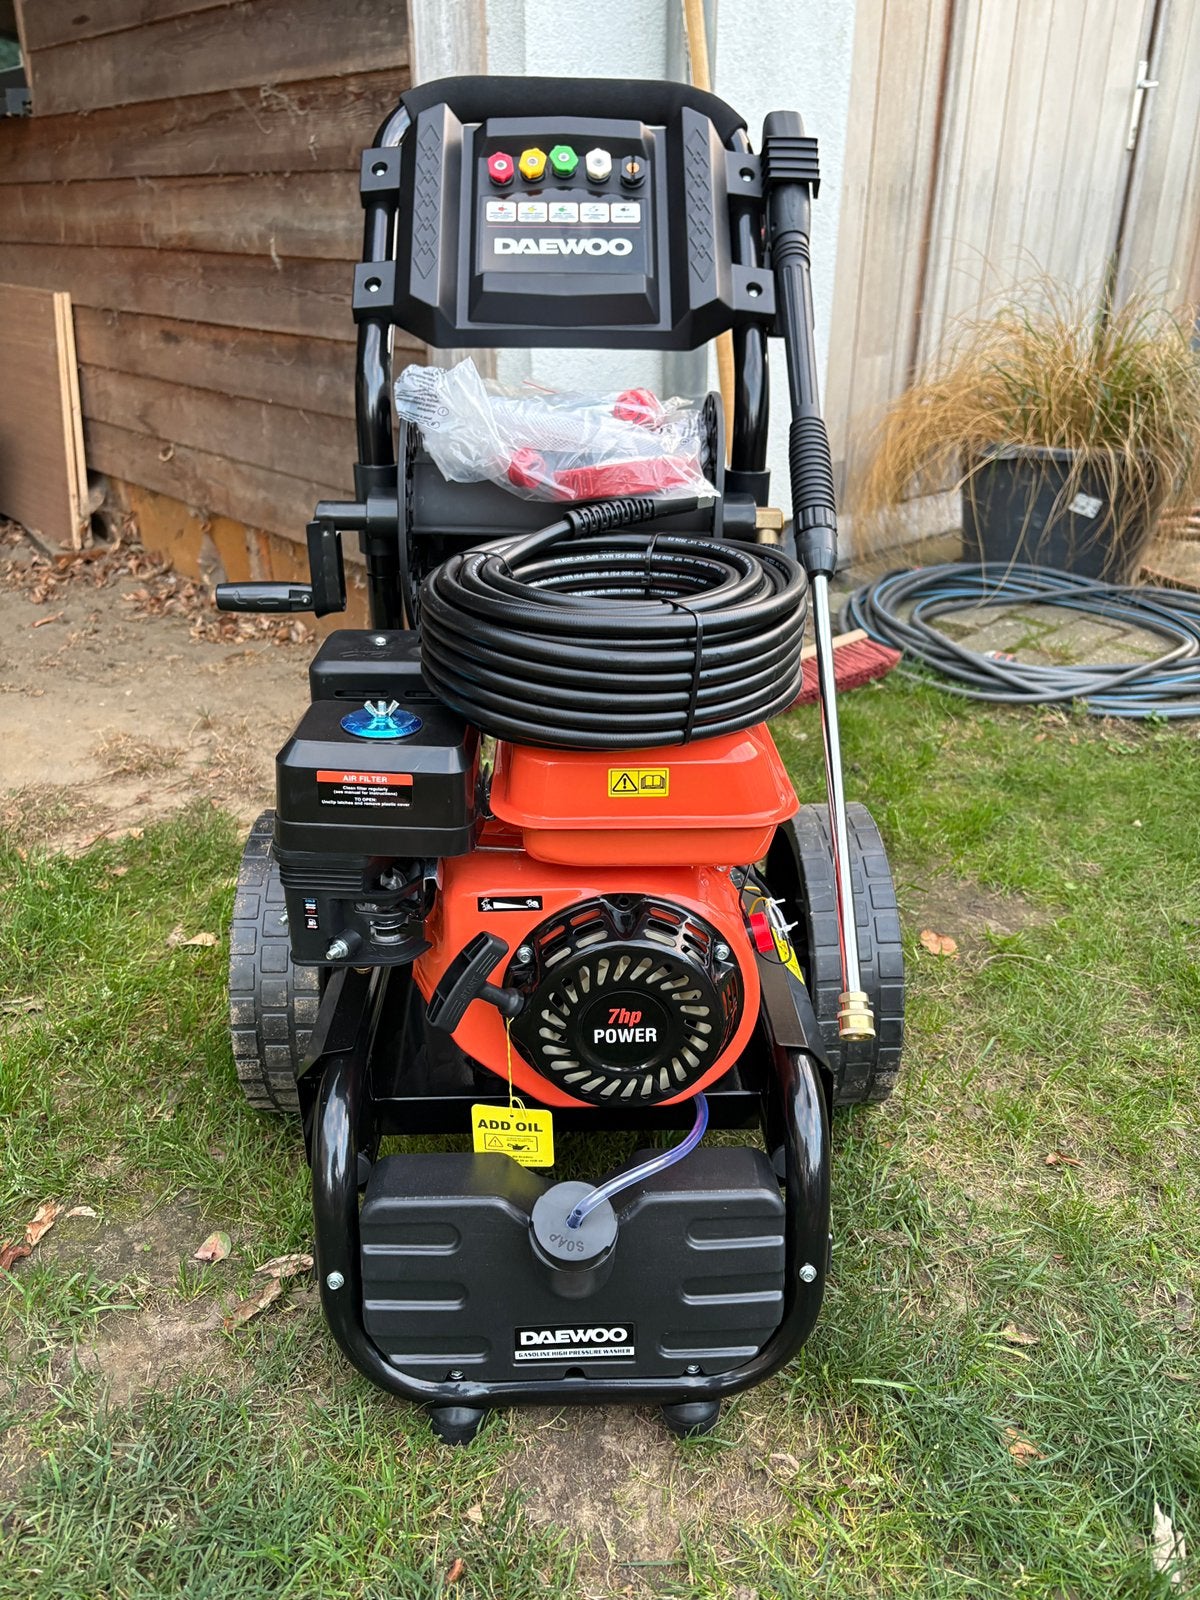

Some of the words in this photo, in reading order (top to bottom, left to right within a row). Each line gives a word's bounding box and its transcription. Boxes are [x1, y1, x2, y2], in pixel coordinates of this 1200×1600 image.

[494, 237, 633, 256] DAEWOO
[342, 774, 358, 782] AIR
[359, 775, 388, 783] FILTER
[608, 1007, 642, 1027] 7hp
[593, 1027, 657, 1044] POWER
[478, 1119, 511, 1131] ADD
[515, 1122, 544, 1133] OIL
[549, 1233, 585, 1253] SOAP
[520, 1327, 628, 1346] DAEWOO
[518, 1350, 552, 1358] GASOLINE
